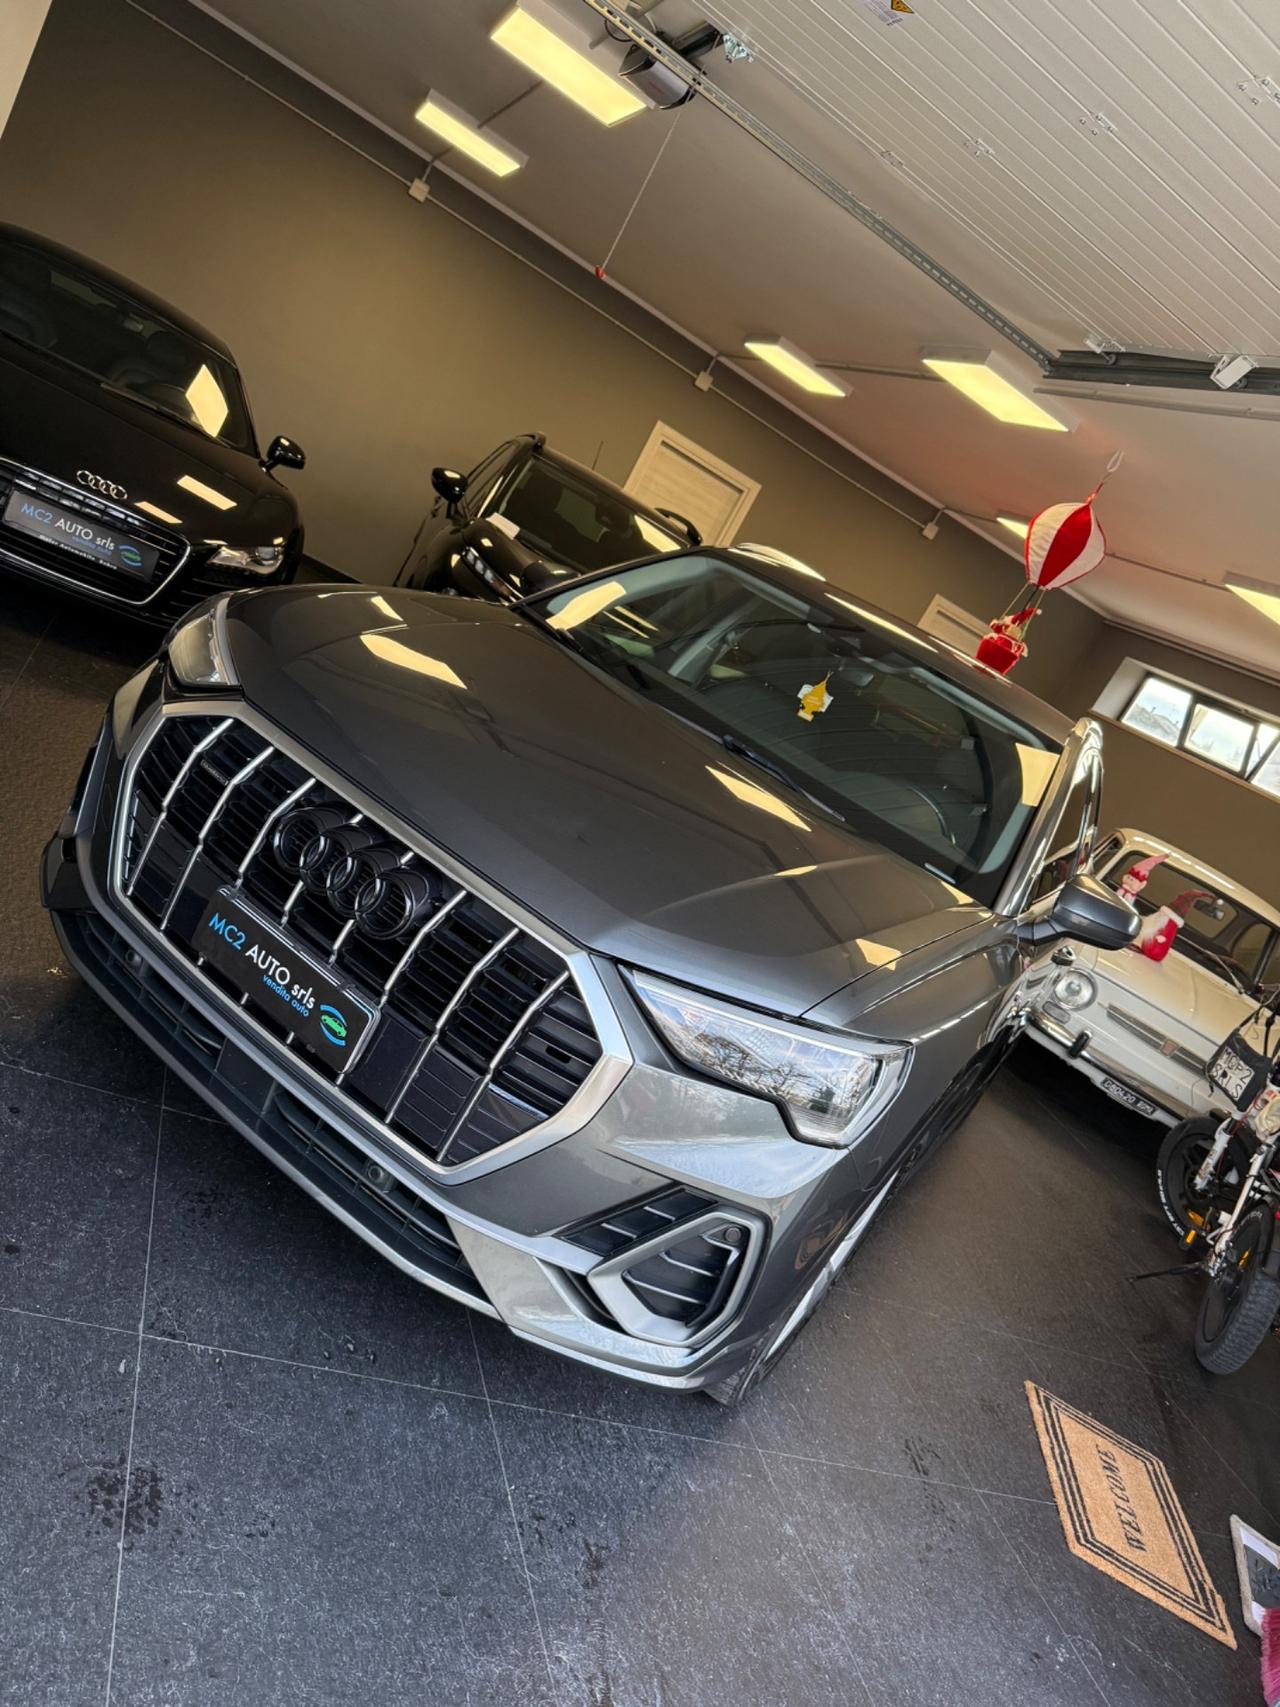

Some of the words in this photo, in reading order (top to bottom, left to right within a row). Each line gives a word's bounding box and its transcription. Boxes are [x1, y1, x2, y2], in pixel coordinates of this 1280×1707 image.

[20, 503, 53, 524] MC2
[54, 518, 93, 540] AUTO
[95, 537, 115, 550] srls
[208, 912, 247, 950] MC2
[245, 944, 291, 986] AUTO
[291, 983, 316, 1009] srls
[262, 974, 290, 1001] vendita
[291, 999, 309, 1018] auto
[1096, 1444, 1148, 1553] WELCOME
